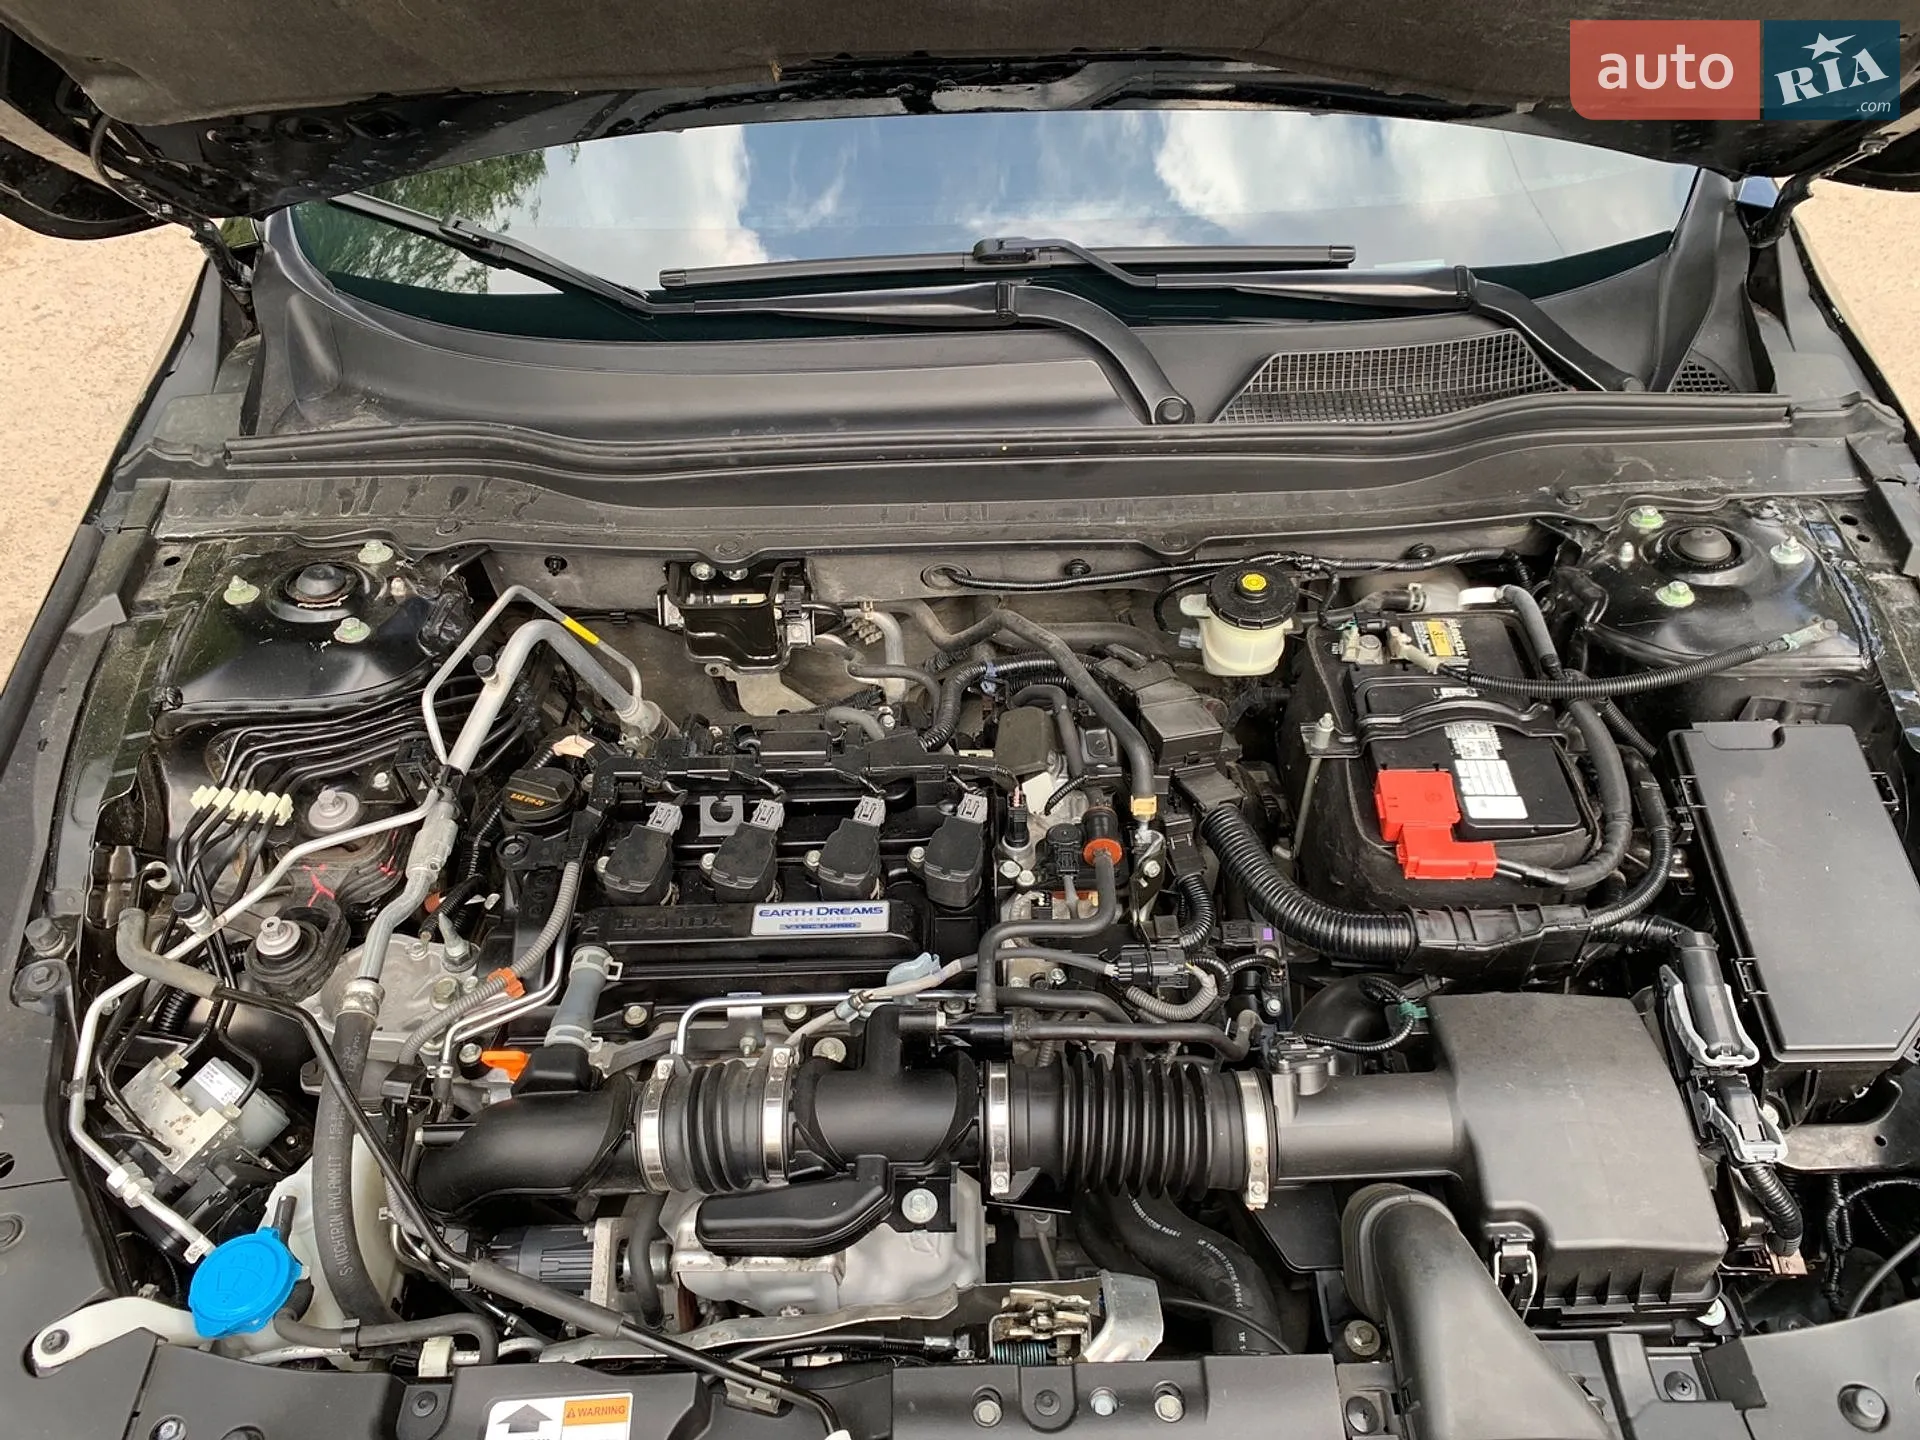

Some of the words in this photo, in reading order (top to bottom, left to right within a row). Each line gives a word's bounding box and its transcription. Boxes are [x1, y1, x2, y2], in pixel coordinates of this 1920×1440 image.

[759, 908, 813, 917] EARTH
[817, 906, 883, 916] DREAMS
[577, 1405, 626, 1417] WARNING
